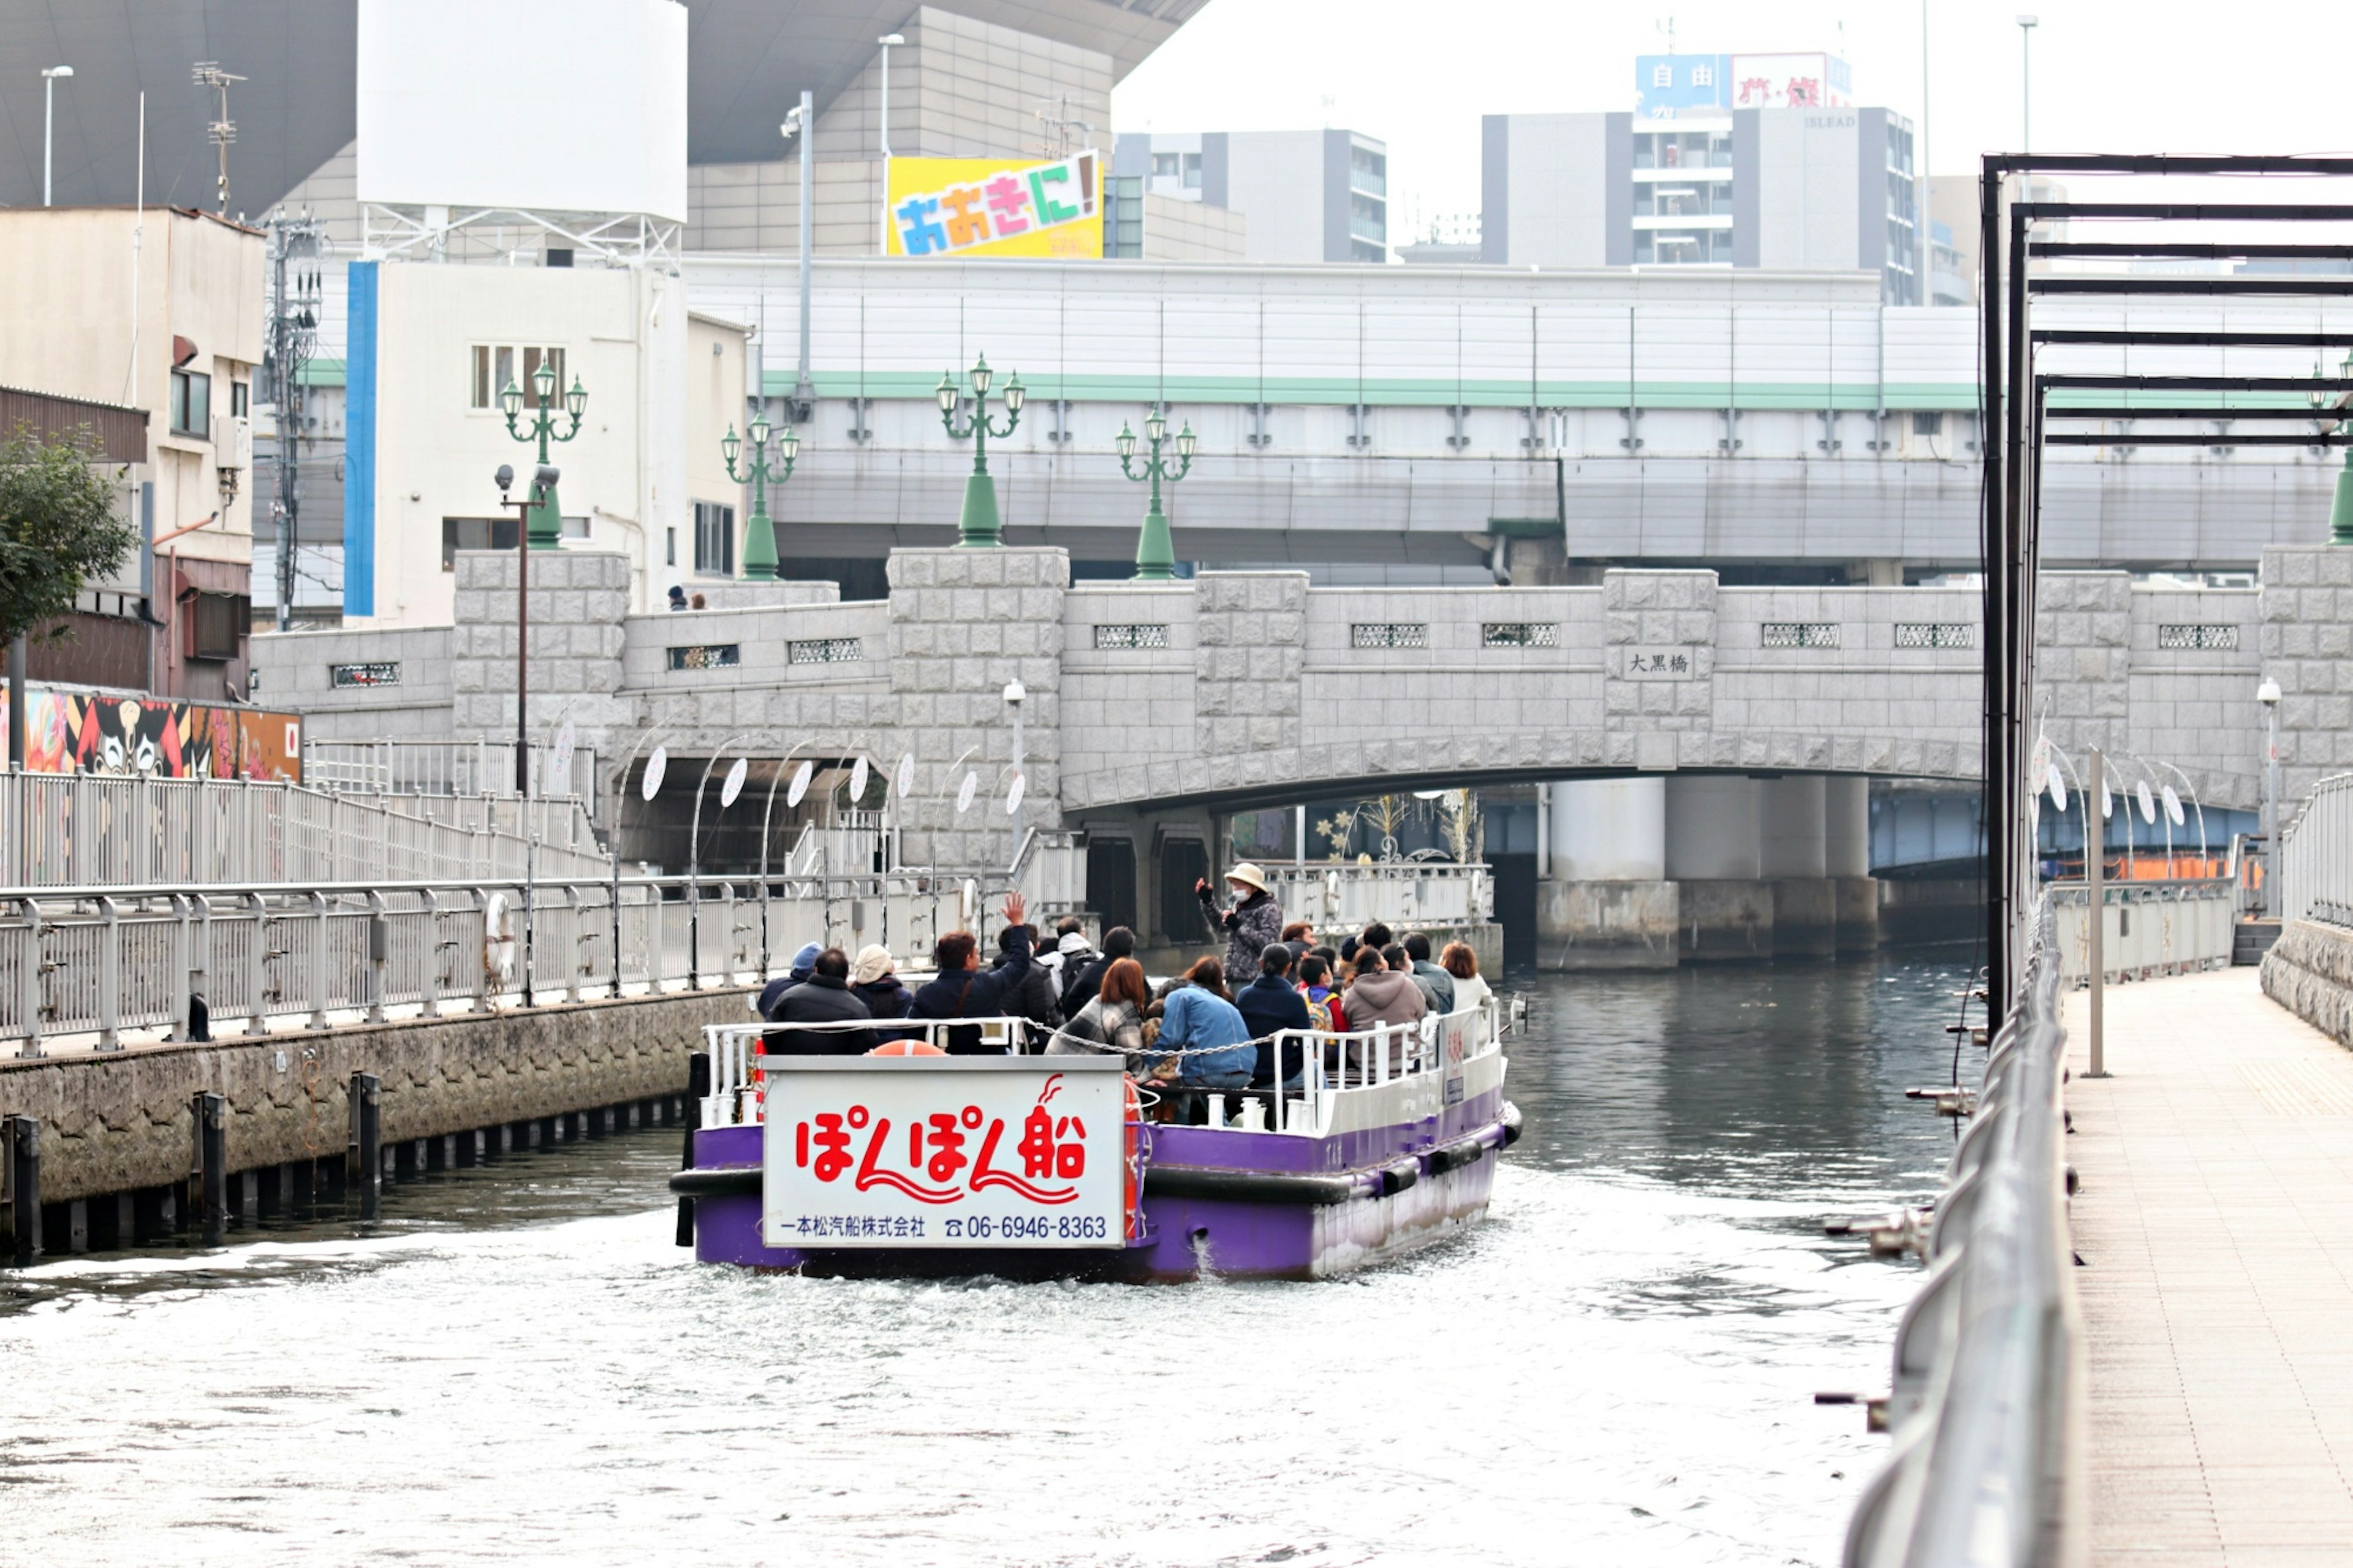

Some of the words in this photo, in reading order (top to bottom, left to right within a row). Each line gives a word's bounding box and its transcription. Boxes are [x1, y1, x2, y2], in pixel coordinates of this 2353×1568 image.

[1629, 653, 1689, 673] 大黒橋
[796, 1105, 1087, 1204] ぽんぽん船
[781, 1215, 925, 1237] 一本松汽船株式会社
[968, 1216, 1106, 1238] 06-6946-8363
